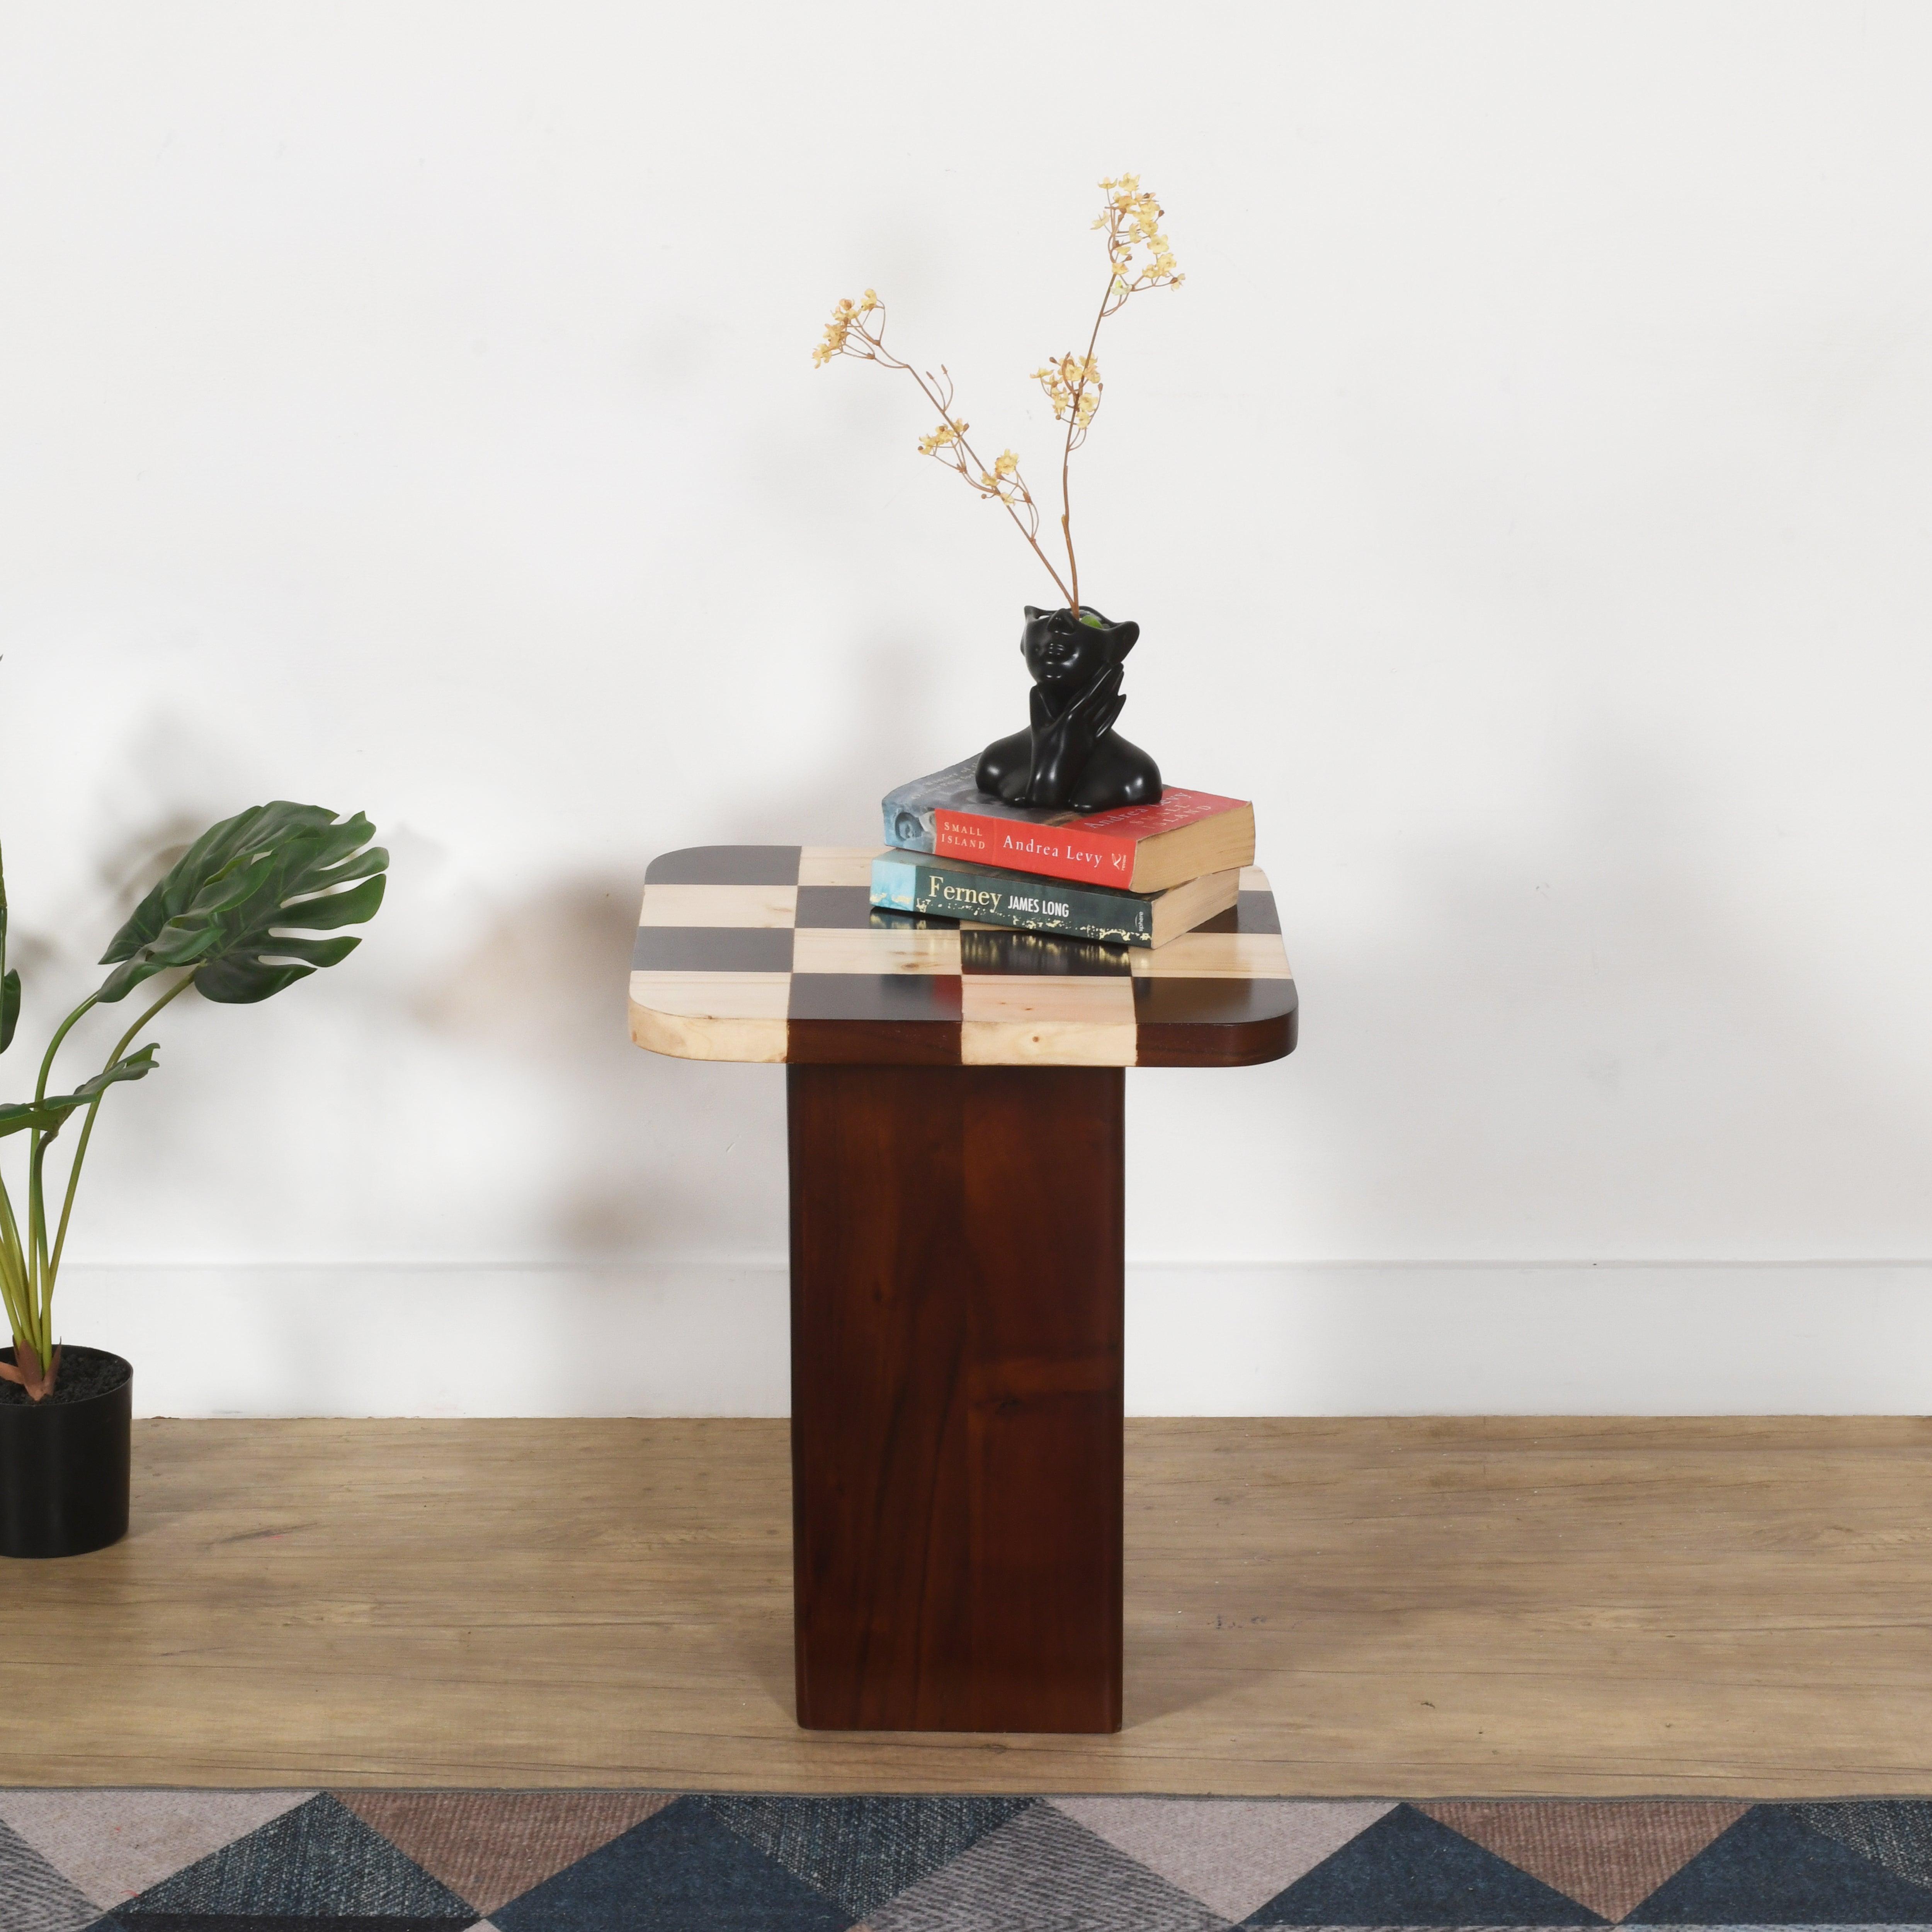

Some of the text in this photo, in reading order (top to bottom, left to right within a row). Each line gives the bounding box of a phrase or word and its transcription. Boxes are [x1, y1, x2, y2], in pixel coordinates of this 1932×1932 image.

[1084, 808, 1148, 829] Andrea
[1129, 804, 1190, 824] SMALL
[1142, 805, 1211, 829] ISLAND
[944, 822, 983, 837] SMALL
[941, 833, 985, 849] ISLAND
[1003, 835, 1103, 868] Andrea Levy
[928, 875, 1002, 913] Ferney
[1007, 895, 1069, 918] JAMES LONG
